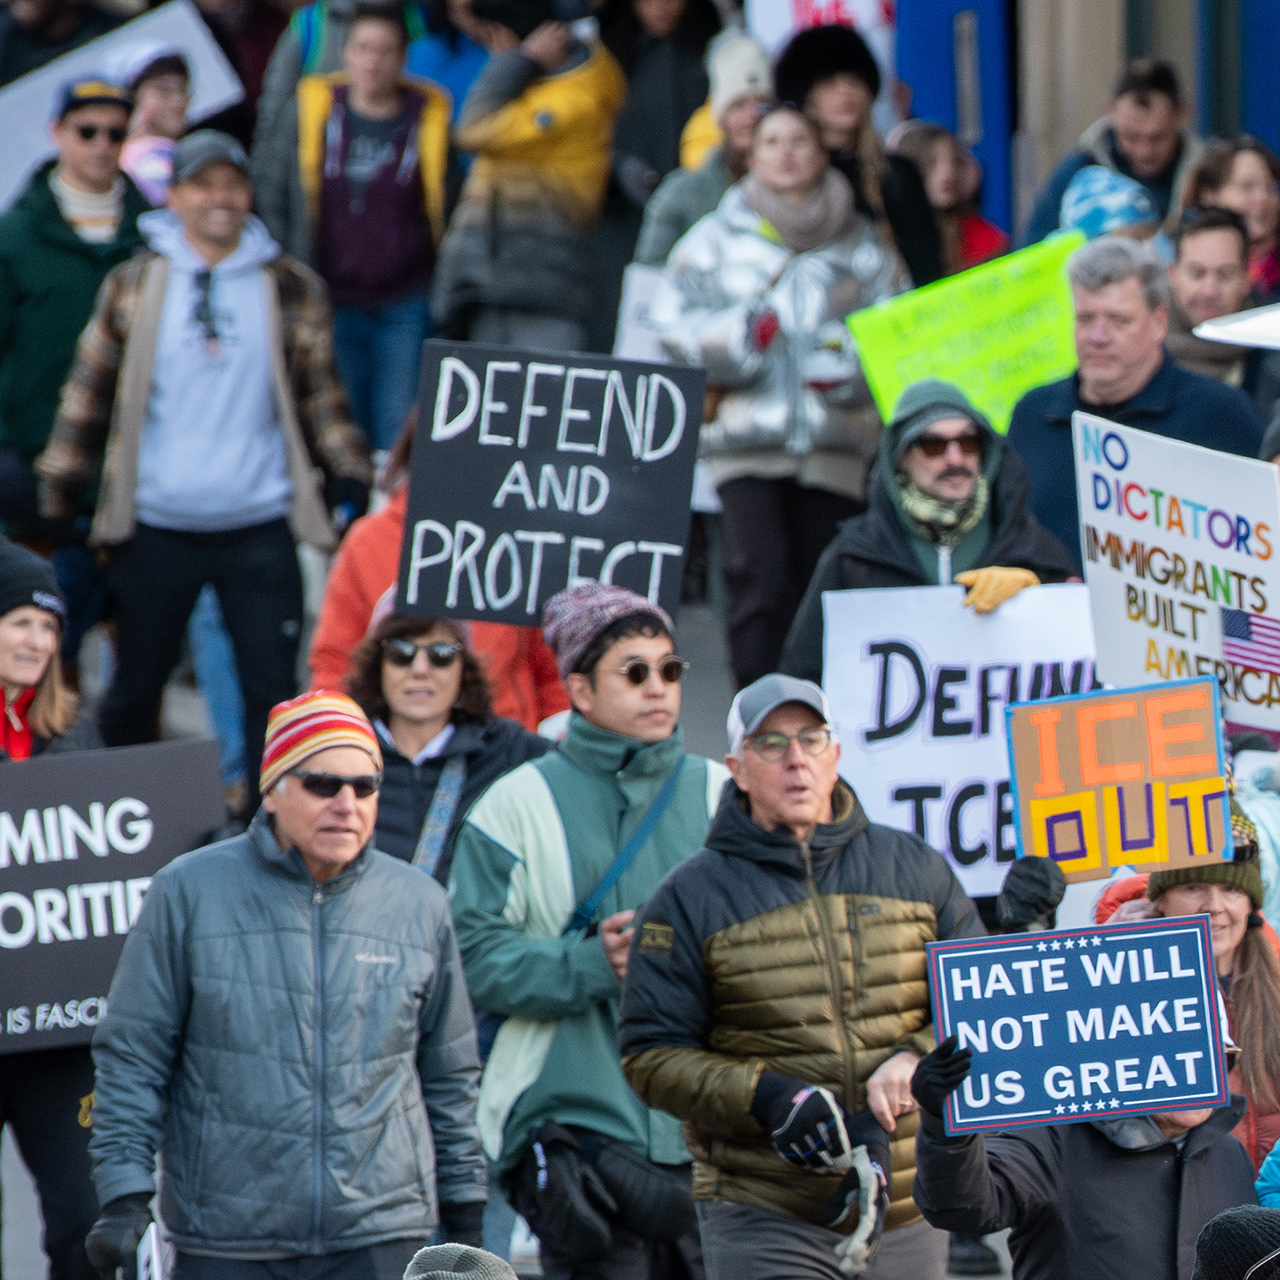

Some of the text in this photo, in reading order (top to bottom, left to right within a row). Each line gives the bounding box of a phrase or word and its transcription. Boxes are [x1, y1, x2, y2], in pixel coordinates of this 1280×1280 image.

[431, 357, 686, 461] DEFEND
[1083, 421, 1129, 472] NO
[492, 461, 610, 516] AND
[1091, 472, 1273, 561] DICTATORS
[406, 520, 683, 614] PROTECT
[1084, 524, 1267, 612] IMMIGRANTS
[1126, 585, 1209, 642] BUILT
[1031, 689, 1217, 797] ICE
[1030, 777, 1227, 880] OUT
[950, 944, 1196, 1001] HATE WILL
[956, 998, 1201, 1054] NOT MAKE
[962, 1052, 1203, 1110] US GREAT
